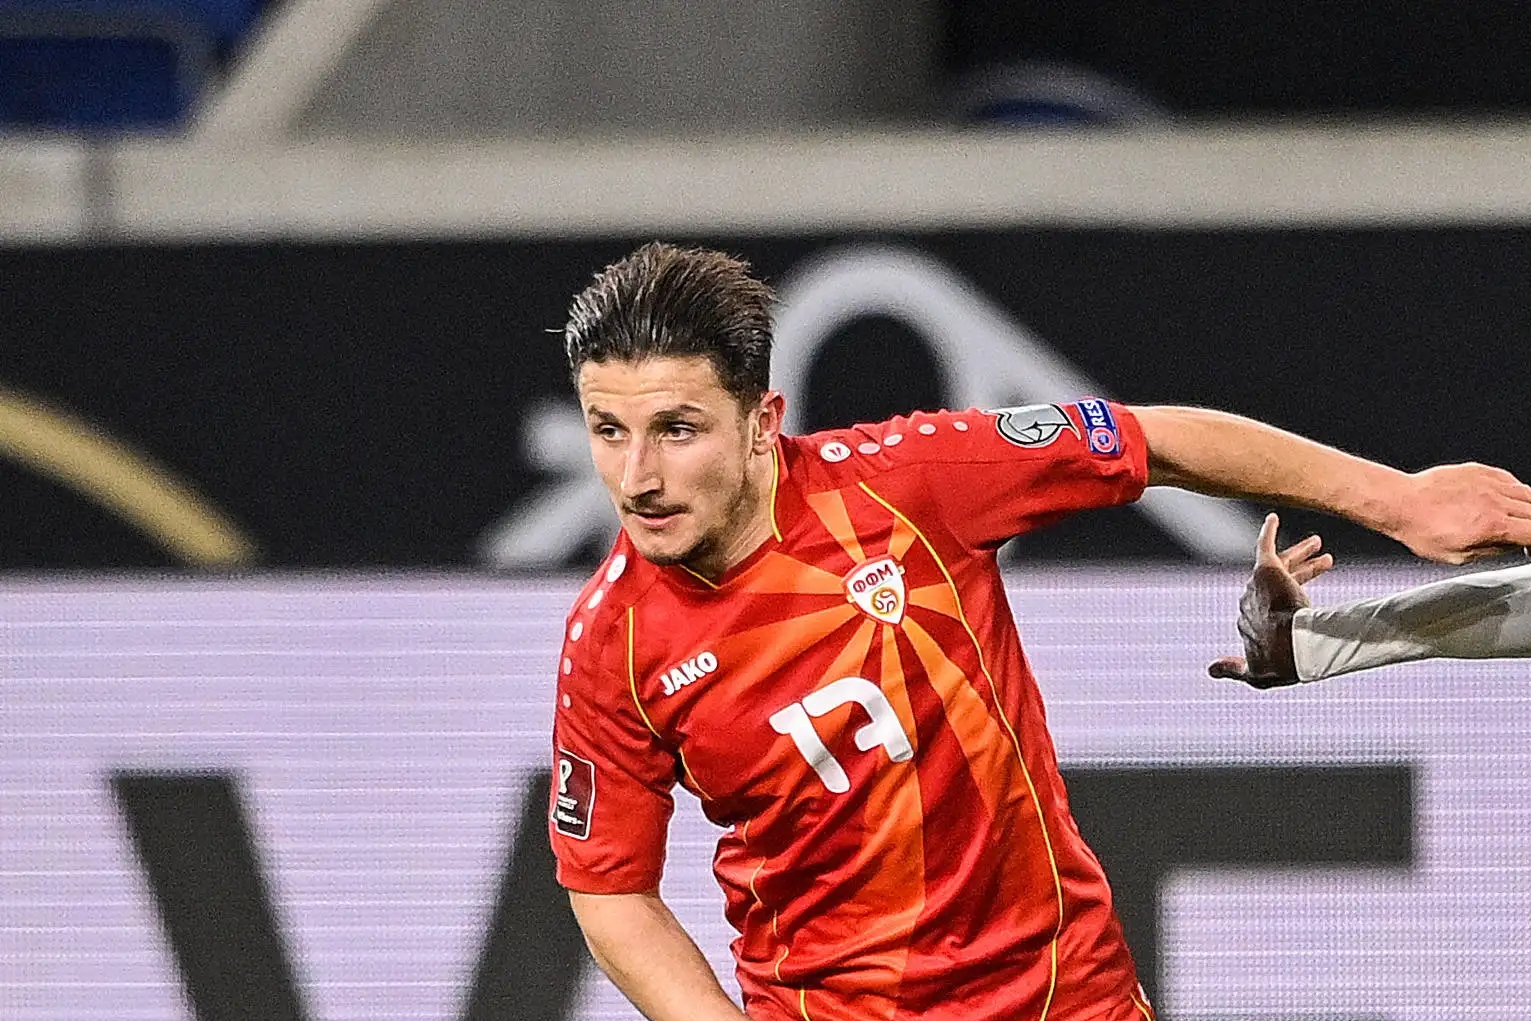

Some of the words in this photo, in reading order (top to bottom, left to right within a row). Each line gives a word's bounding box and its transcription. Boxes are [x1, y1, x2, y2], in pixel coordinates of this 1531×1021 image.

[853, 564, 893, 593] ФФМ
[660, 651, 718, 696] JAKO
[768, 677, 915, 794] 17
